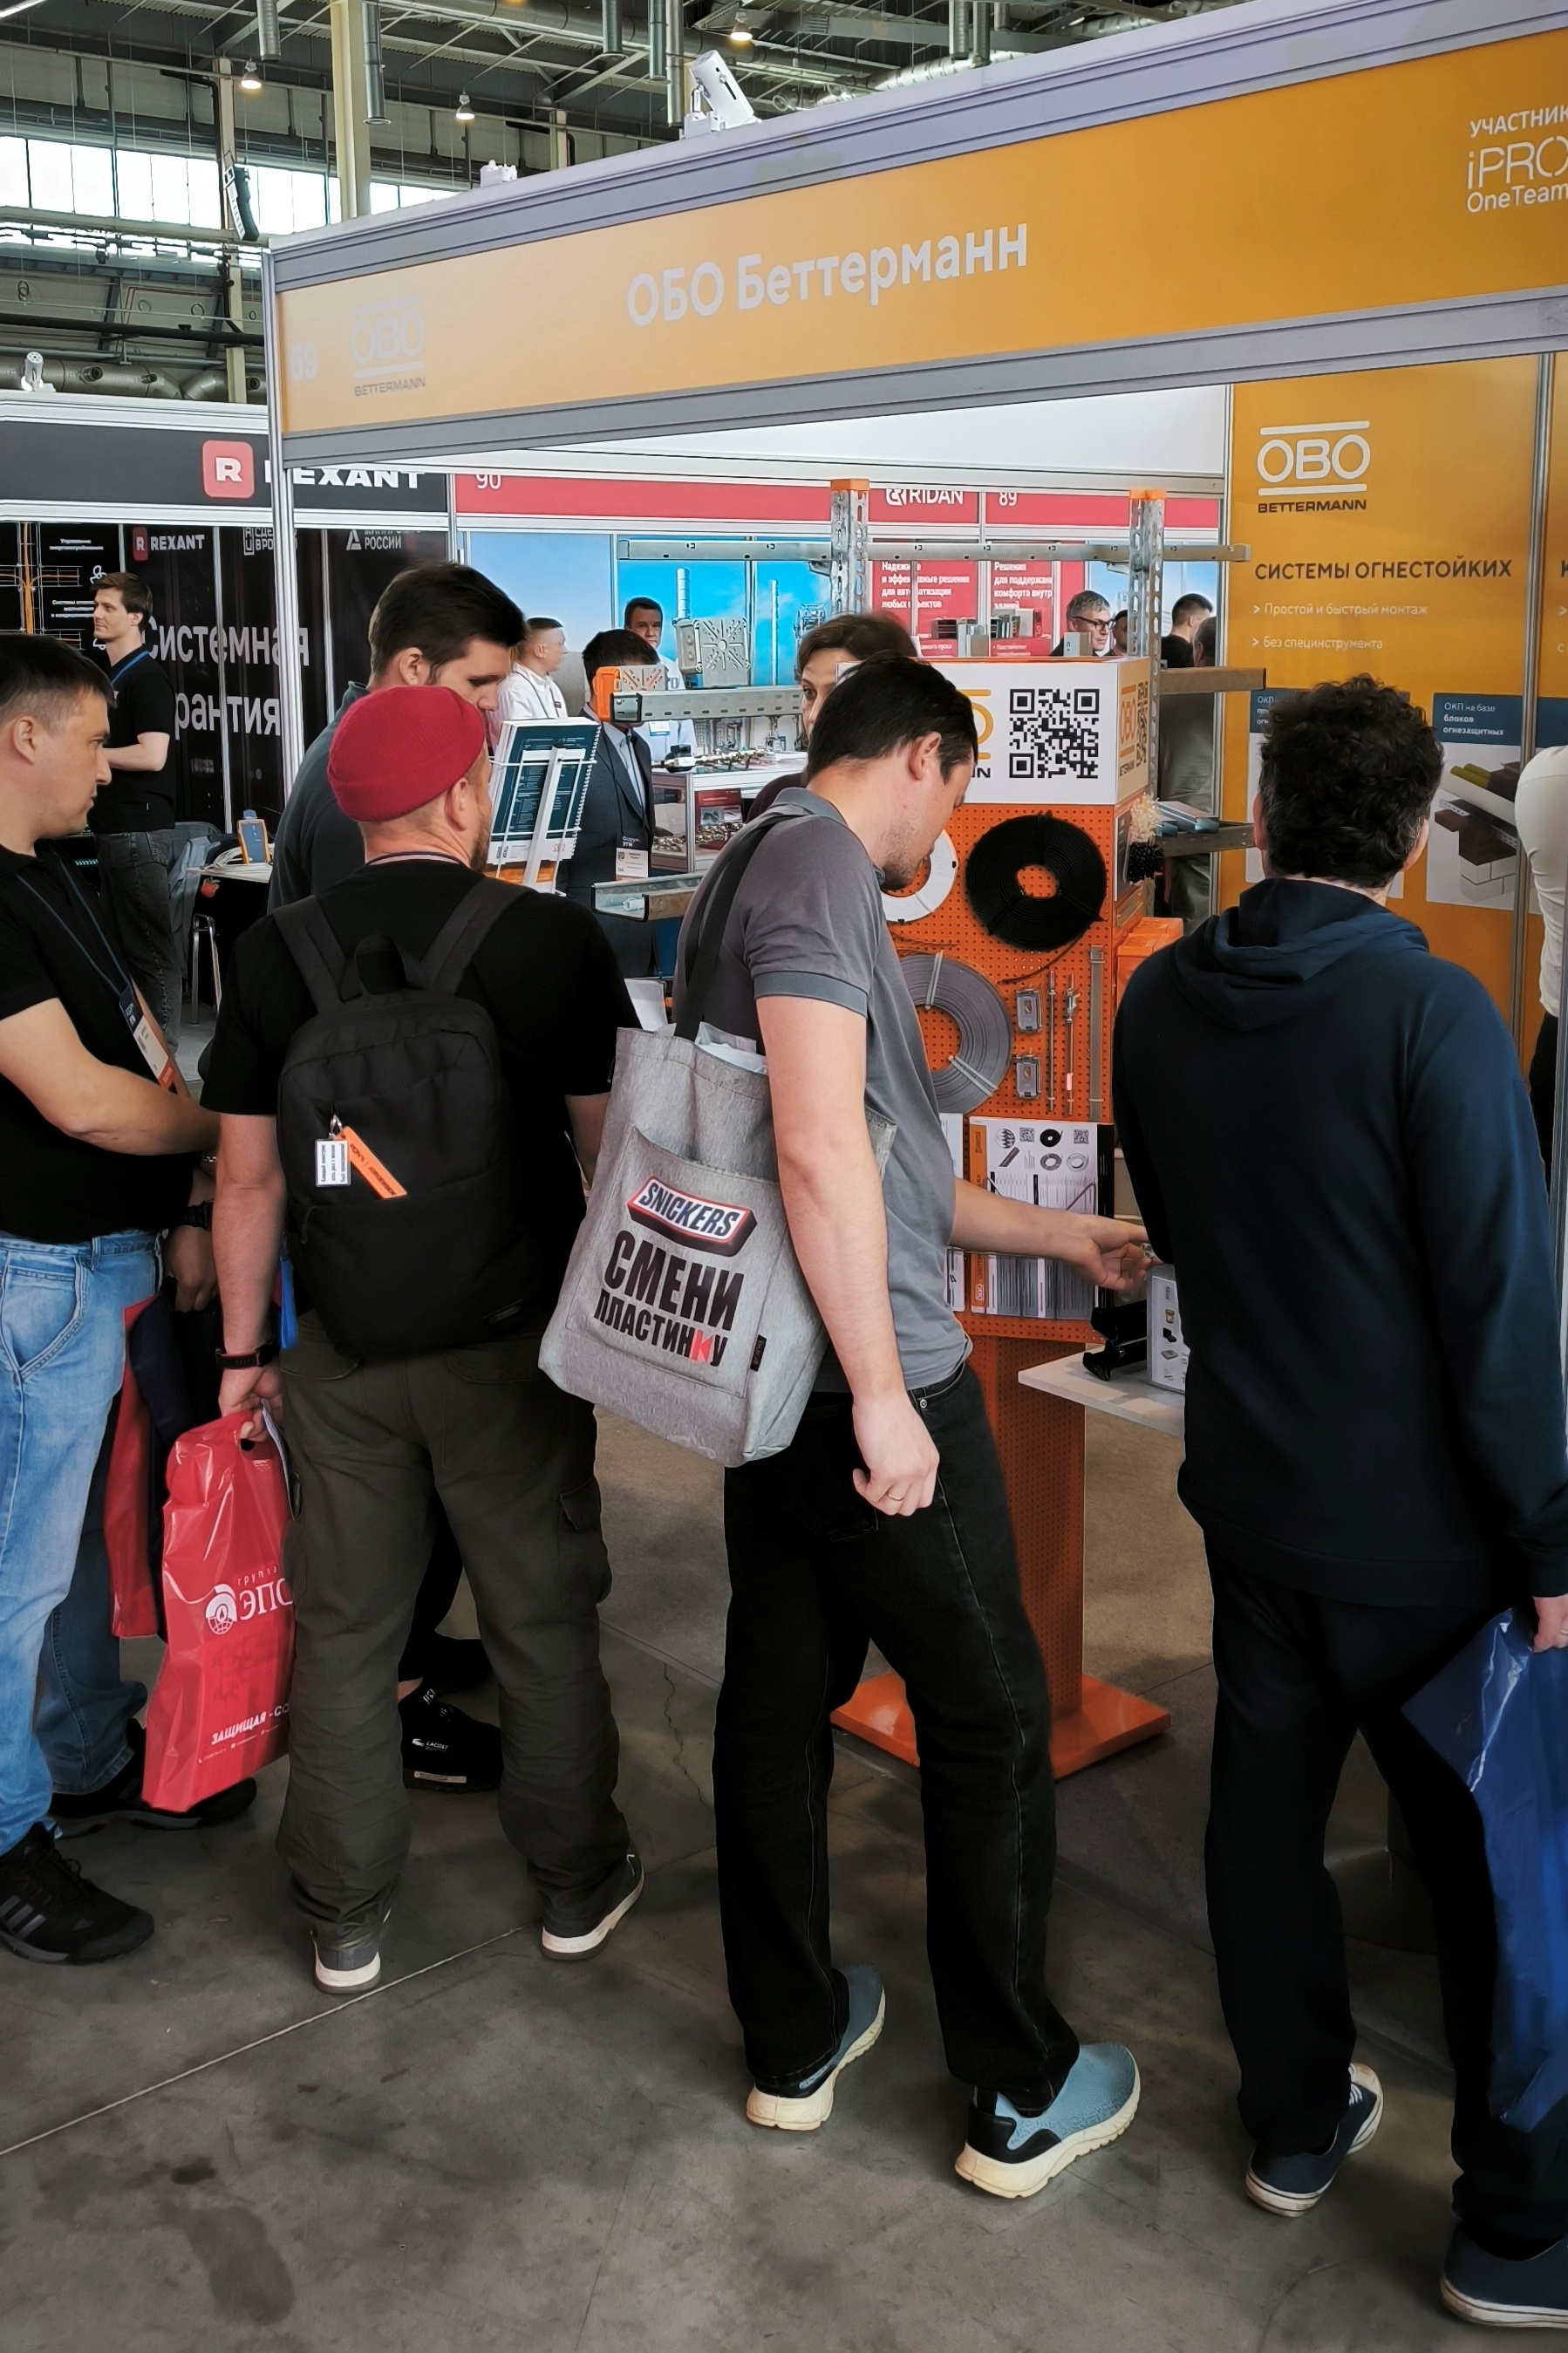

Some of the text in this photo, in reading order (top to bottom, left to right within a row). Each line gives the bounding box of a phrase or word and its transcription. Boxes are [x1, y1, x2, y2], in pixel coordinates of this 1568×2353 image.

[1467, 183, 1568, 213] OneTeam
[626, 222, 1028, 327] ОБО Беттерманн
[351, 309, 426, 365] OBO
[354, 377, 426, 397] BETTERMANN
[1257, 433, 1371, 483] OBO
[264, 460, 426, 489] EXANT
[475, 474, 501, 489] 90
[909, 489, 964, 506] RIDAN
[999, 492, 1018, 507] 89
[1258, 499, 1367, 514] BETTERMANN
[150, 534, 205, 551] REXANT
[365, 535, 402, 550] РОССИИ
[1255, 555, 1513, 580] СИСТЕМЫ ОГНЕСТОЙКИХ
[1031, 589, 1053, 599] внутр
[1265, 602, 1428, 617] Простой и быстрый монтаж
[1264, 636, 1383, 650] Без специнструмента
[174, 692, 281, 740] рантия
[1444, 701, 1464, 711] ОКП
[1443, 713, 1475, 723] блоков
[638, 1181, 741, 1238] SNICKERS
[603, 1230, 745, 1331] СМЕНИ
[593, 1288, 728, 1367] ПЛАСТИНКУ
[237, 1565, 277, 1586] группа
[211, 1711, 267, 1745] ЗАЩИЩАЯ
